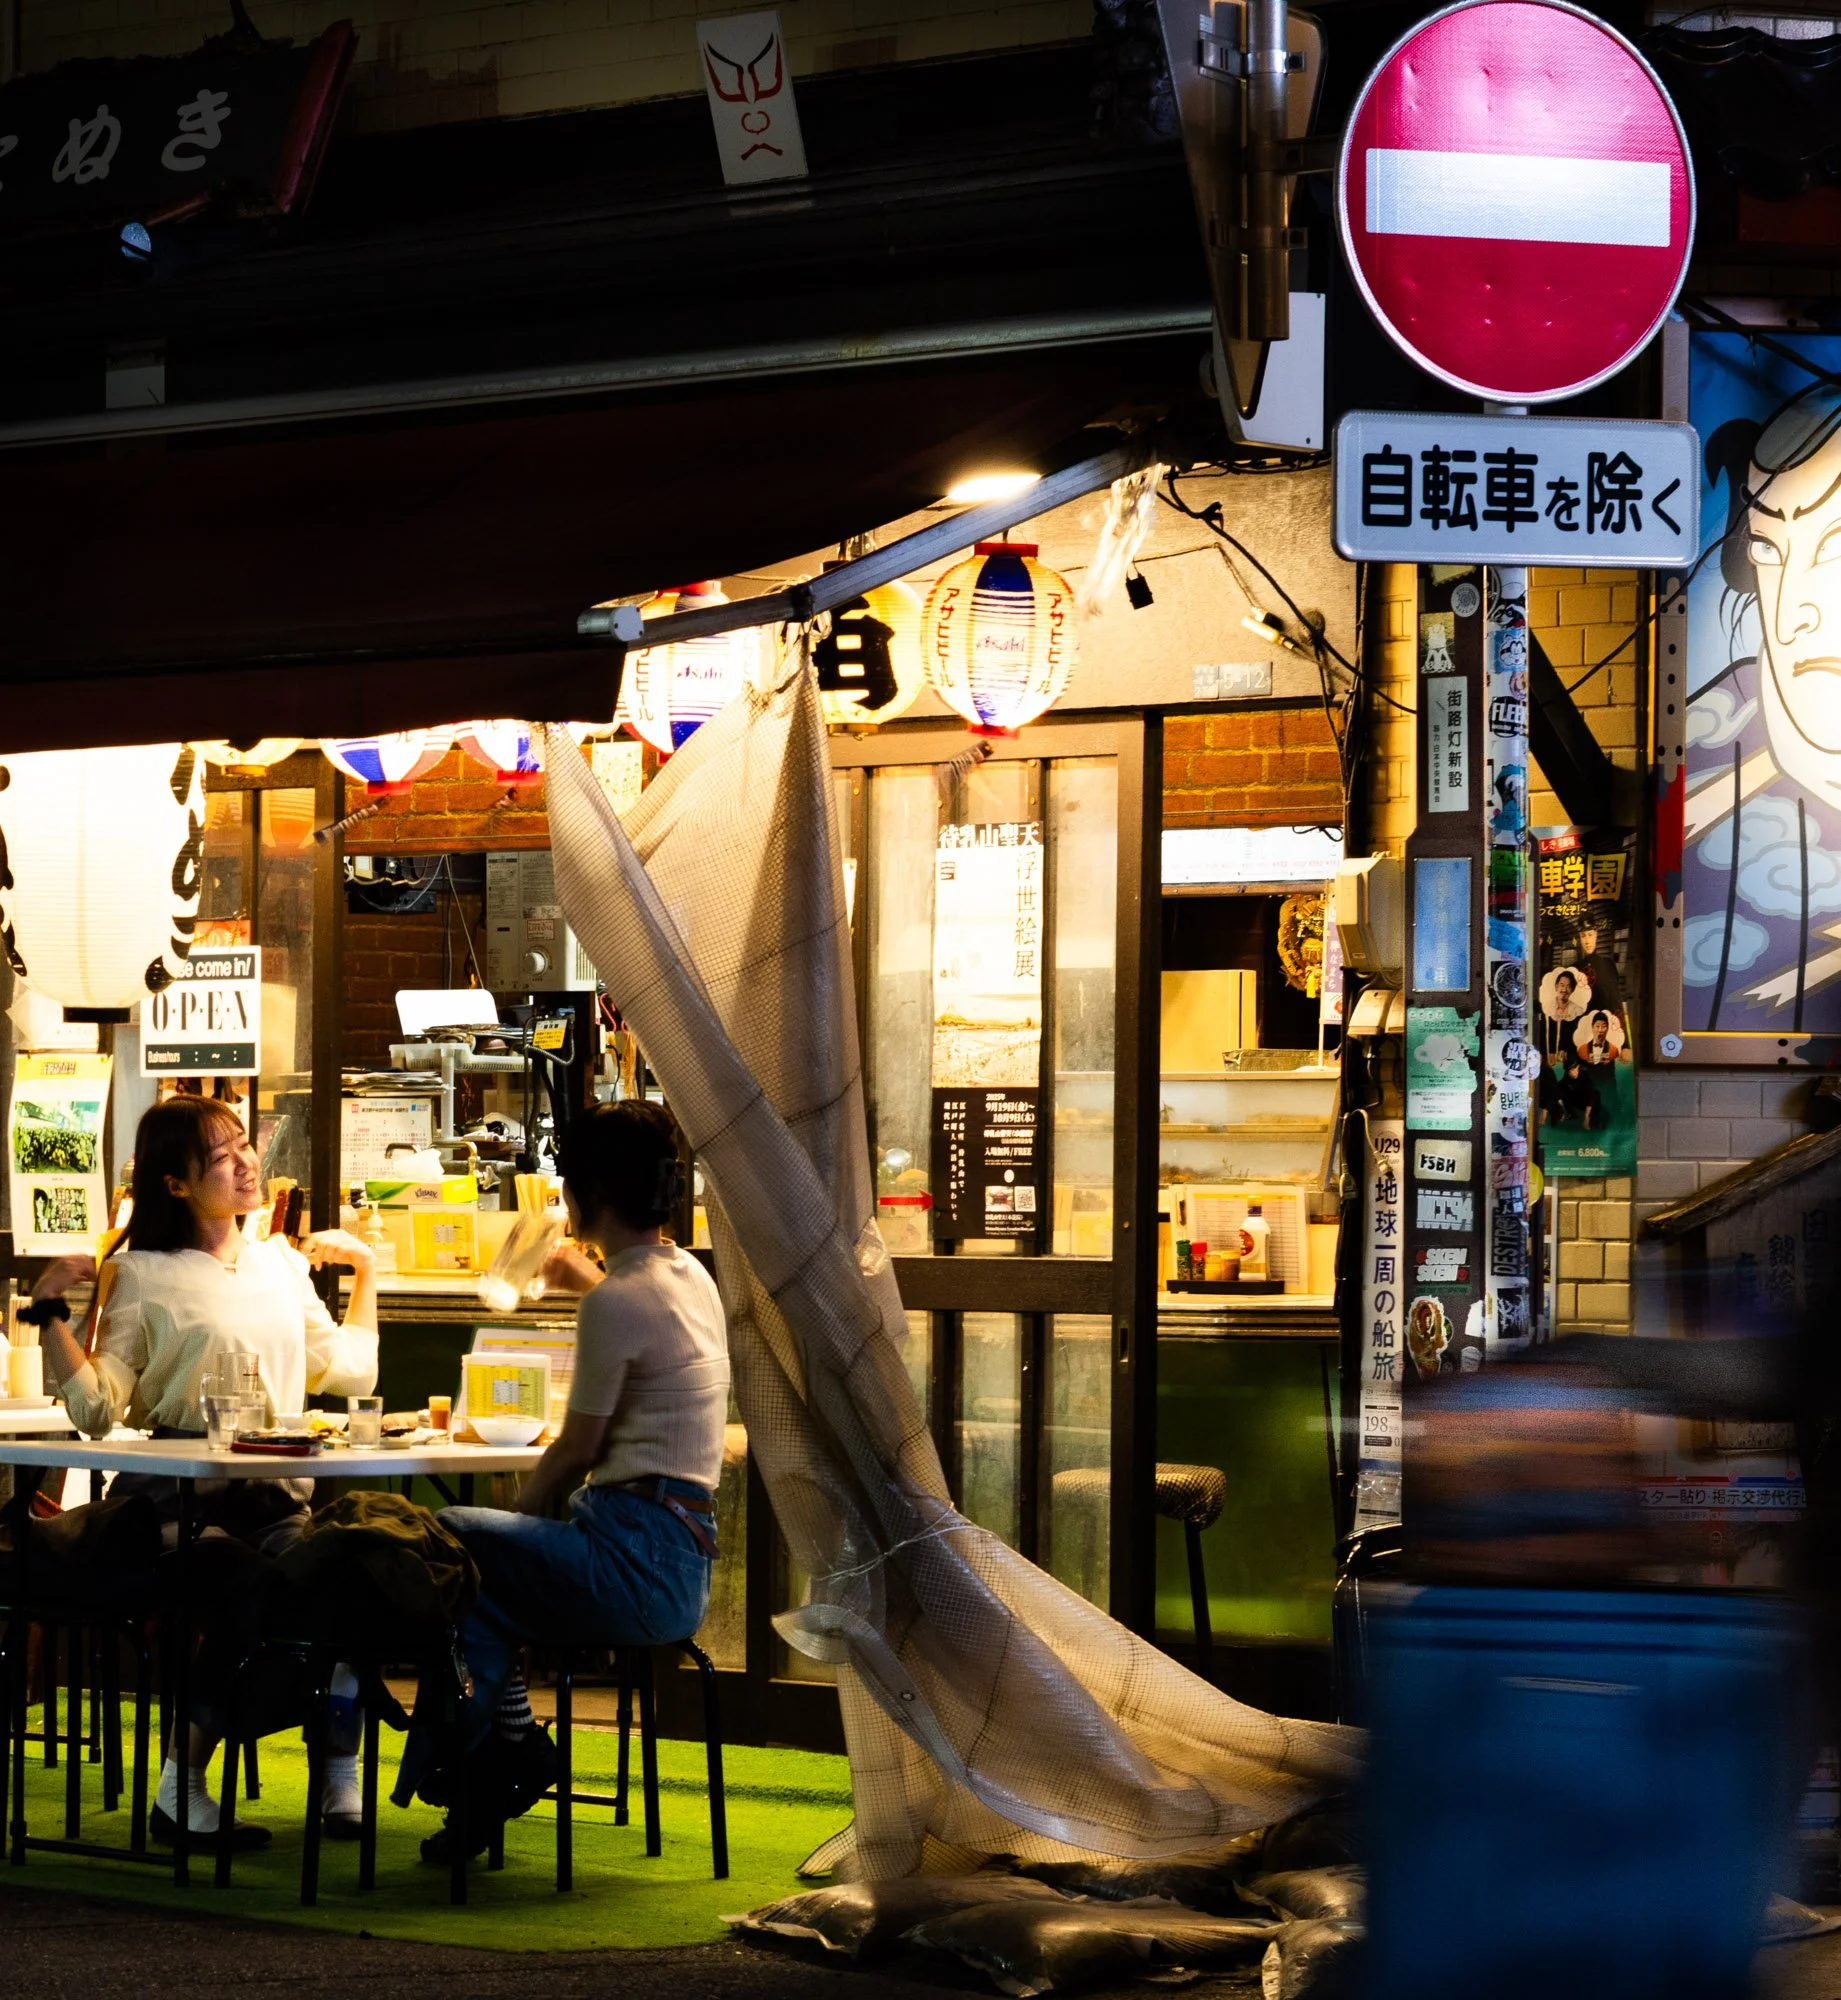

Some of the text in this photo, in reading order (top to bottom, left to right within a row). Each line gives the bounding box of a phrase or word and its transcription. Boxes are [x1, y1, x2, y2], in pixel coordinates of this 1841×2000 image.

[1362, 443, 1681, 535] 自転車を除く
[937, 588, 961, 689] アサヒビール
[1036, 593, 1066, 696] アサヒビール
[1447, 690, 1463, 788] 街路灯新設
[939, 823, 1040, 849] 待乳山聖天
[1014, 852, 1037, 978] 浮世絵展
[195, 960, 232, 977] come
[1375, 1137, 1400, 1154] U29
[1372, 1176, 1397, 1381] 地球一周の船旅
